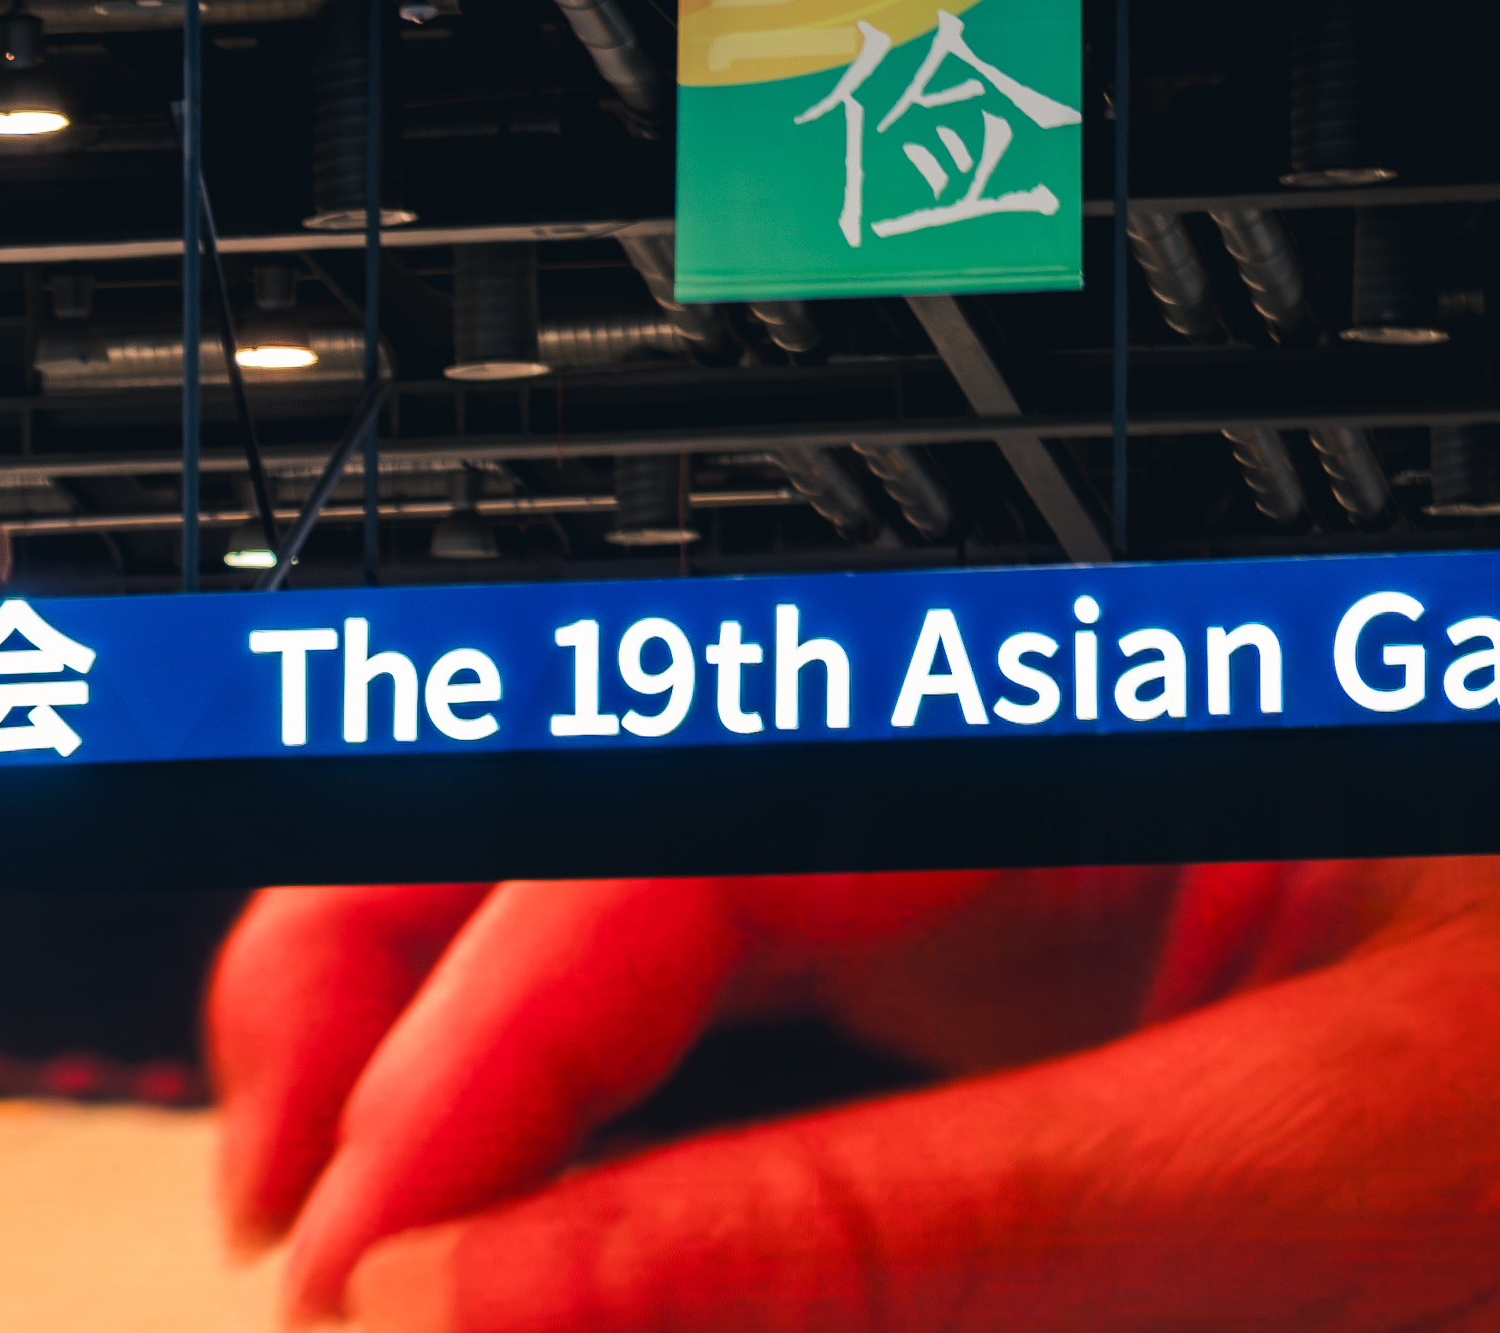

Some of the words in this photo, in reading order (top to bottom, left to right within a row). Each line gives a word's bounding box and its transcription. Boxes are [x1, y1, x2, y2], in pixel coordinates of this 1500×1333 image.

[793, 9, 1082, 248] 俭
[249, 618, 501, 746] The
[551, 604, 849, 736] 19th
[891, 595, 1282, 726] Asian
